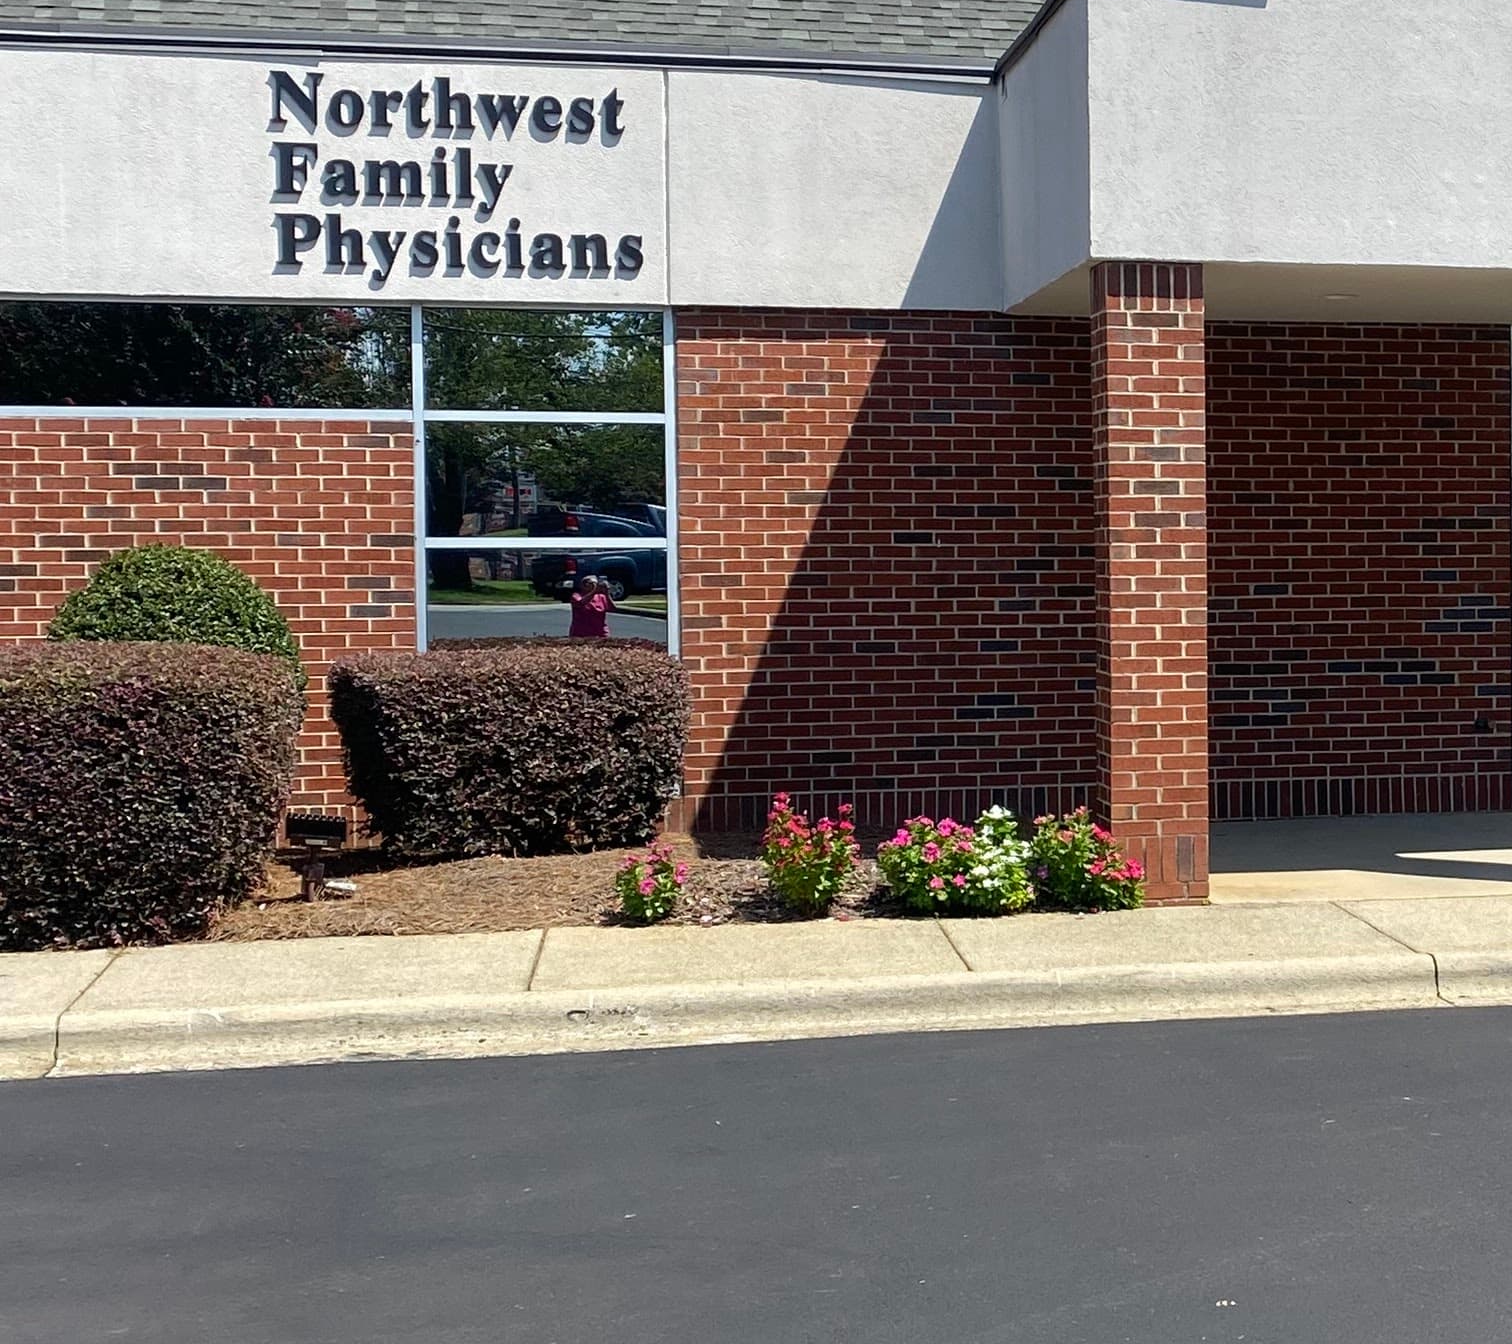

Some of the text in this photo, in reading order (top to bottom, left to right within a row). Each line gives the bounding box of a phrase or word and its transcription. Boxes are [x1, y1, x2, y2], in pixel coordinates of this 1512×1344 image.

[268, 70, 625, 142] Northwest
[271, 142, 514, 218] Family
[272, 213, 644, 286] Physicians
